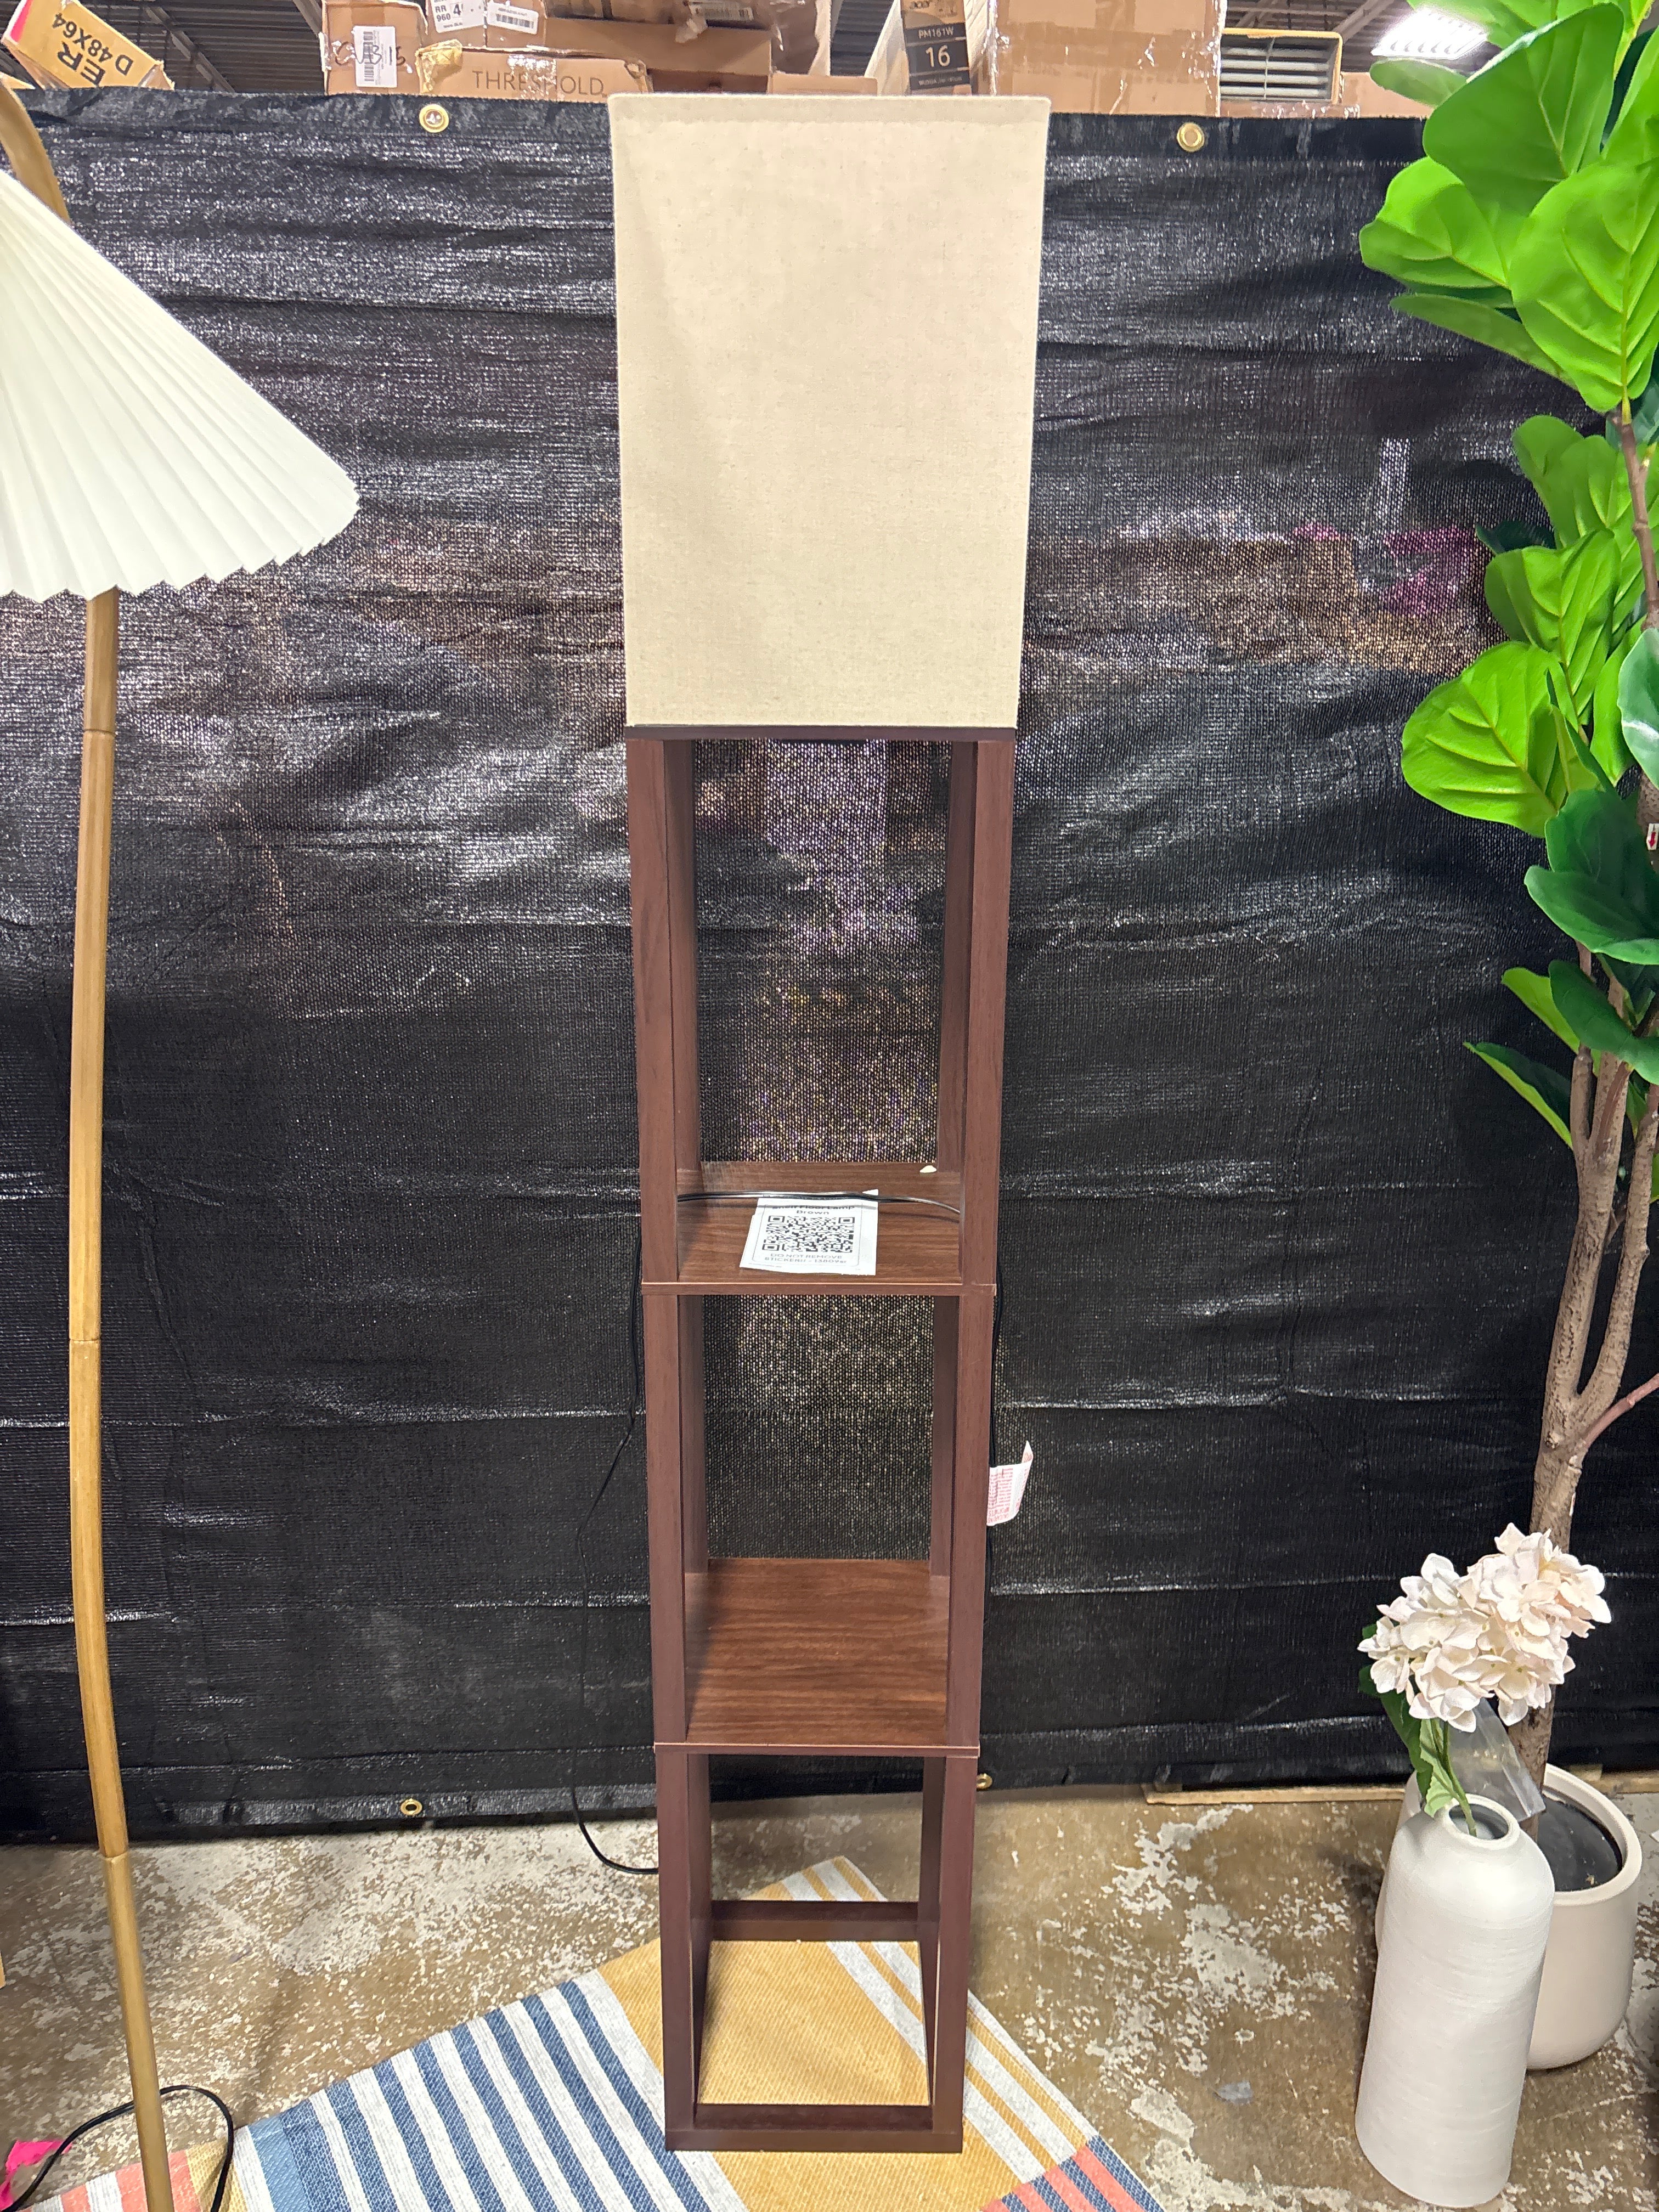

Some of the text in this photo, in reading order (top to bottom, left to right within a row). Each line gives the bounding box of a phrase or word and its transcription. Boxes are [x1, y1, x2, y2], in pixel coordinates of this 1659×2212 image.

[52, 13, 134, 76] D 48X64
[918, 26, 954, 40] PM161W
[925, 44, 951, 67] 16
